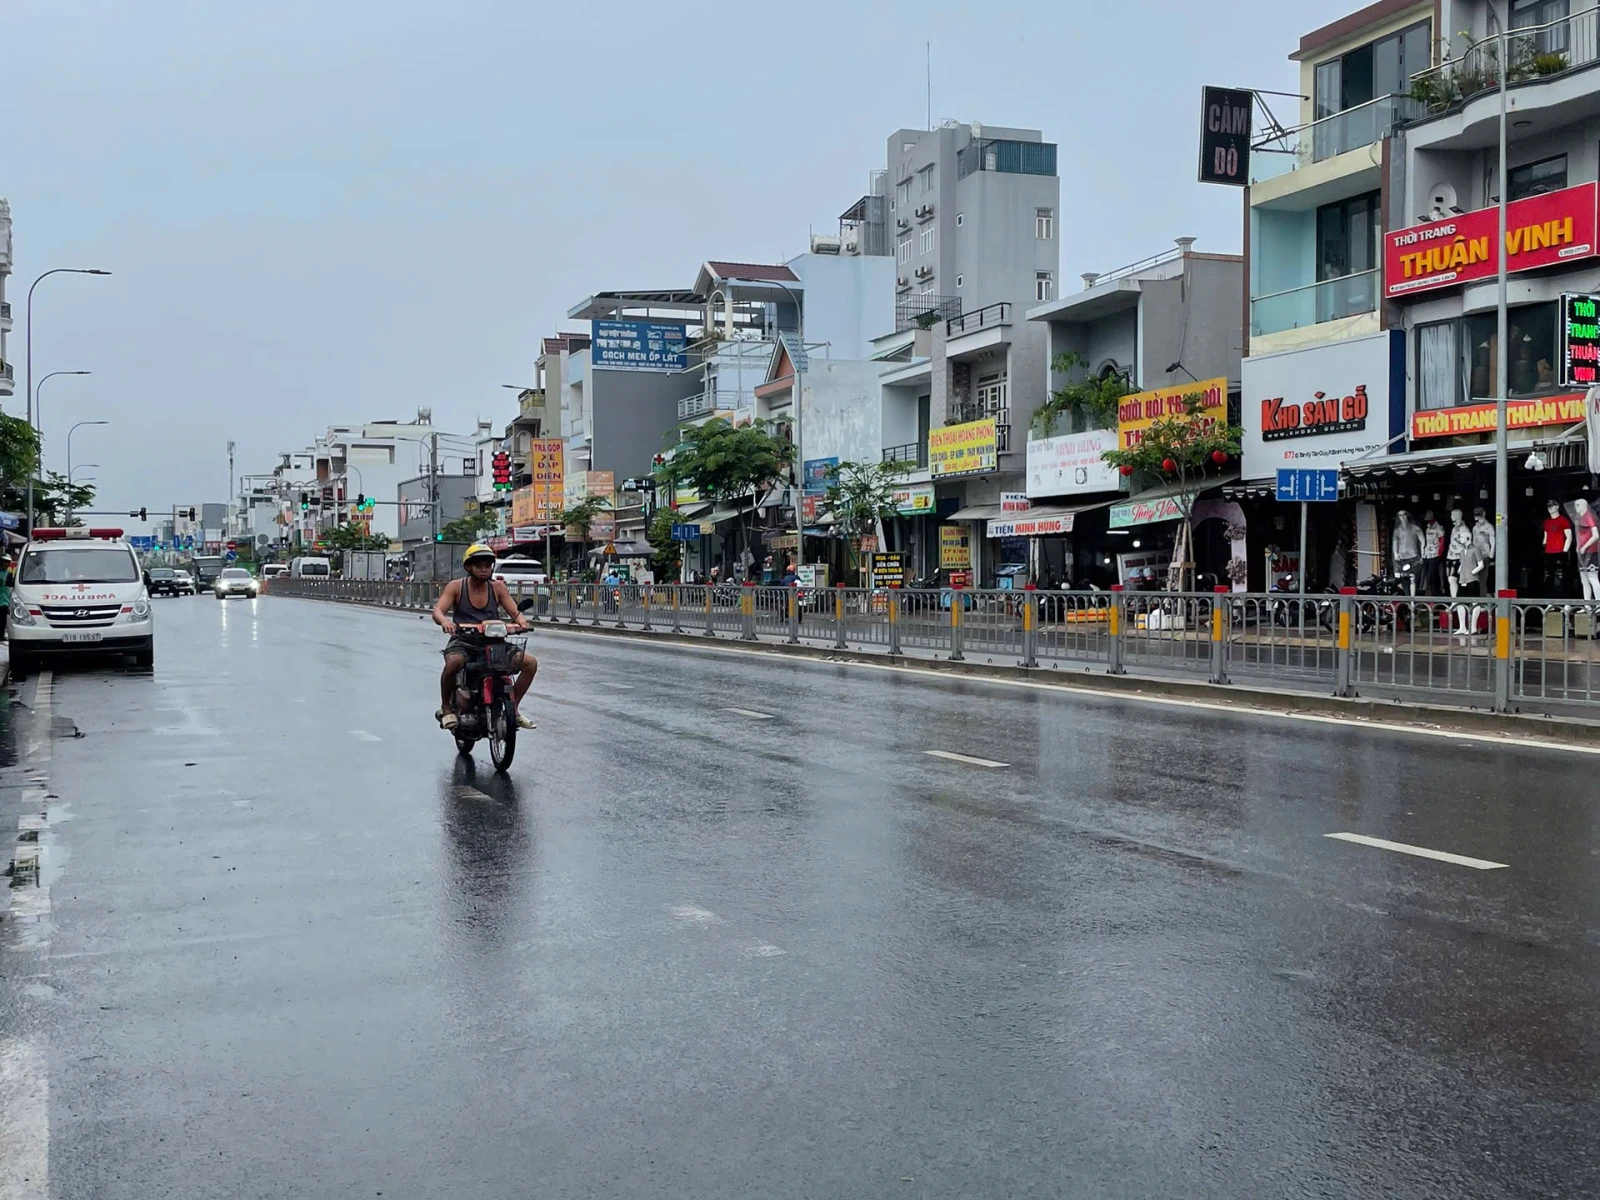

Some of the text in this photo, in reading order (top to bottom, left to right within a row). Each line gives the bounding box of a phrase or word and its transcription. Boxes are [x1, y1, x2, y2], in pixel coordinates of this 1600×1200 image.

[1208, 96, 1247, 135] CẦM
[1214, 138, 1238, 177] ĐỒ
[1394, 224, 1457, 247] THỜI TRANG
[1400, 216, 1573, 278] THUẬN VINH
[1574, 299, 1596, 317] THỜI
[602, 350, 625, 361] GẠCH
[627, 352, 647, 361] MEN
[663, 353, 679, 362] LÁT
[1574, 366, 1596, 381] VINH
[1145, 392, 1165, 418] HỎI
[1342, 384, 1368, 421] GỖ
[1416, 412, 1449, 434] THỜI
[1558, 398, 1586, 420] VIN
[1283, 450, 1295, 459] 873
[995, 523, 1014, 536] TIỆN
[1015, 523, 1036, 534] MINH
